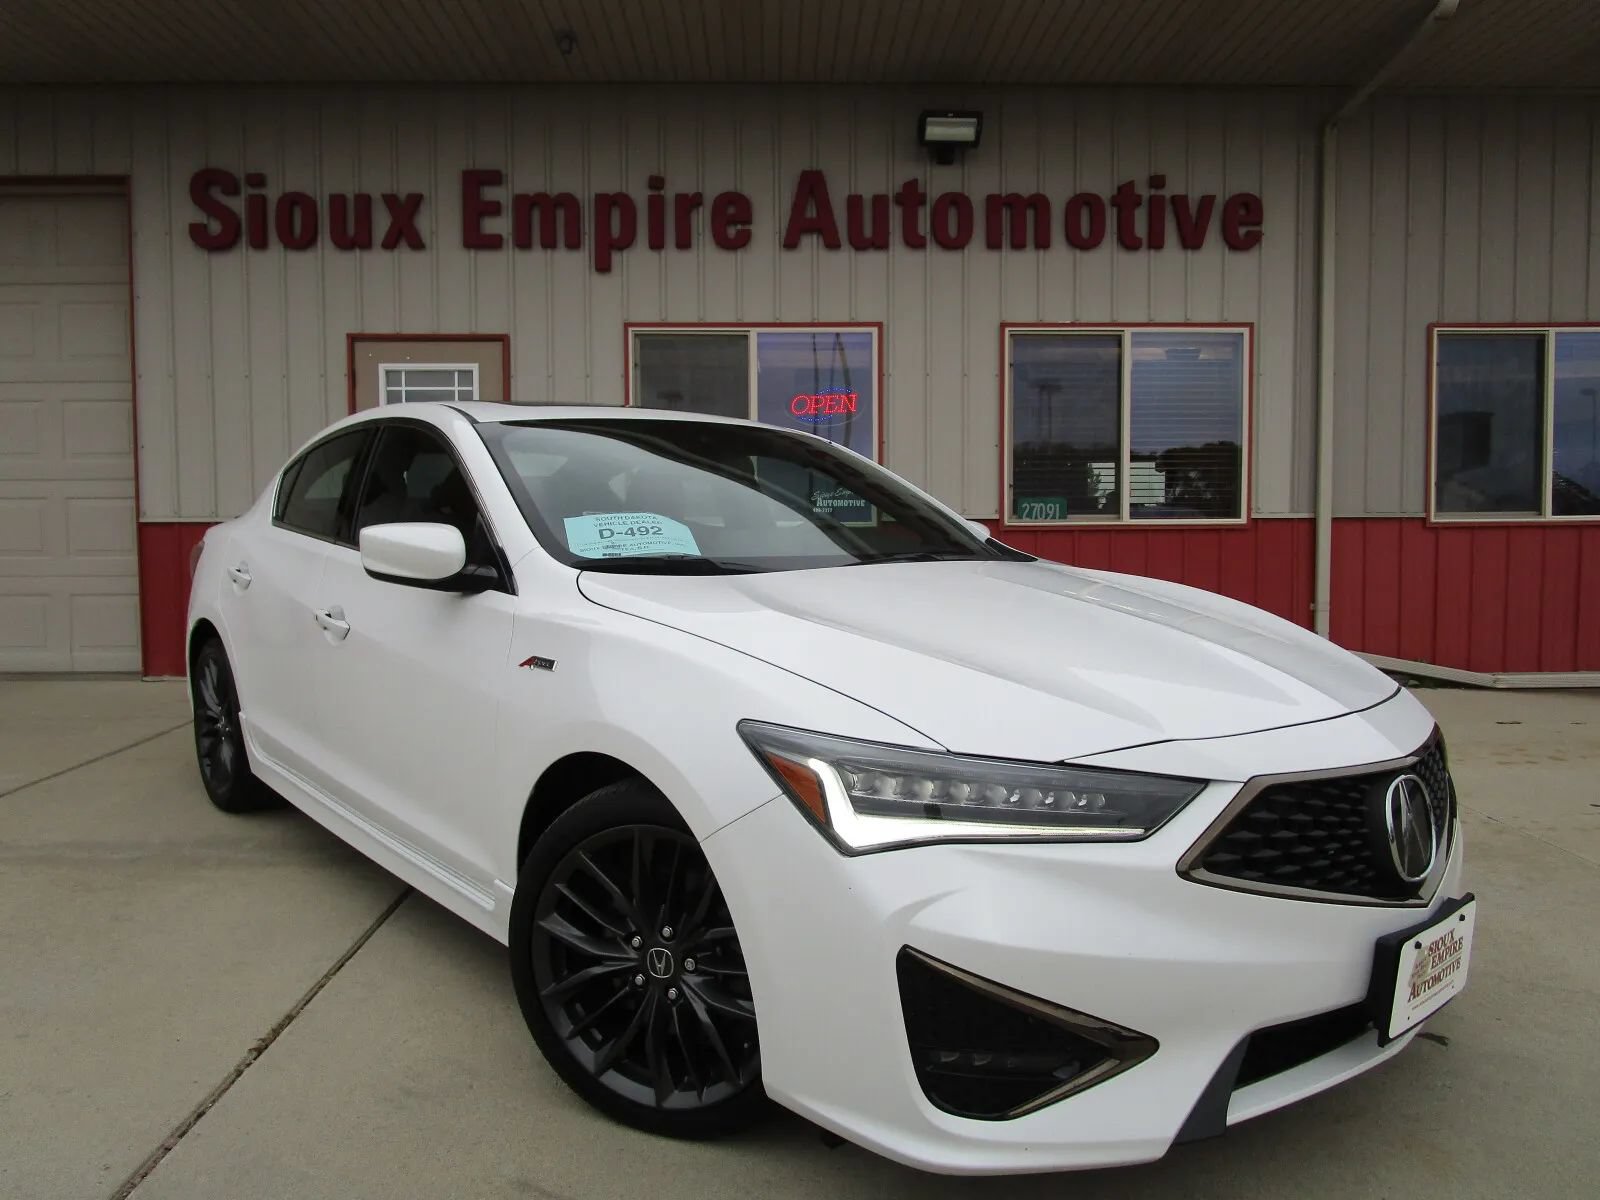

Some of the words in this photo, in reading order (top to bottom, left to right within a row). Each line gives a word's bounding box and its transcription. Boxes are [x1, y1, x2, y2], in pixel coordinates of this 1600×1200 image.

[188, 168, 426, 252] Sioux
[462, 169, 754, 273] Empire
[783, 169, 1264, 252] Automotive
[790, 394, 858, 415] OPEN
[1021, 502, 1060, 520] 27091
[593, 520, 629, 528] VEHICLE
[598, 525, 664, 540] D-492
[1428, 928, 1456, 957] SIOUX
[1430, 936, 1464, 970] EMPIRE
[1407, 957, 1462, 1003] AUTOMOTIVE
